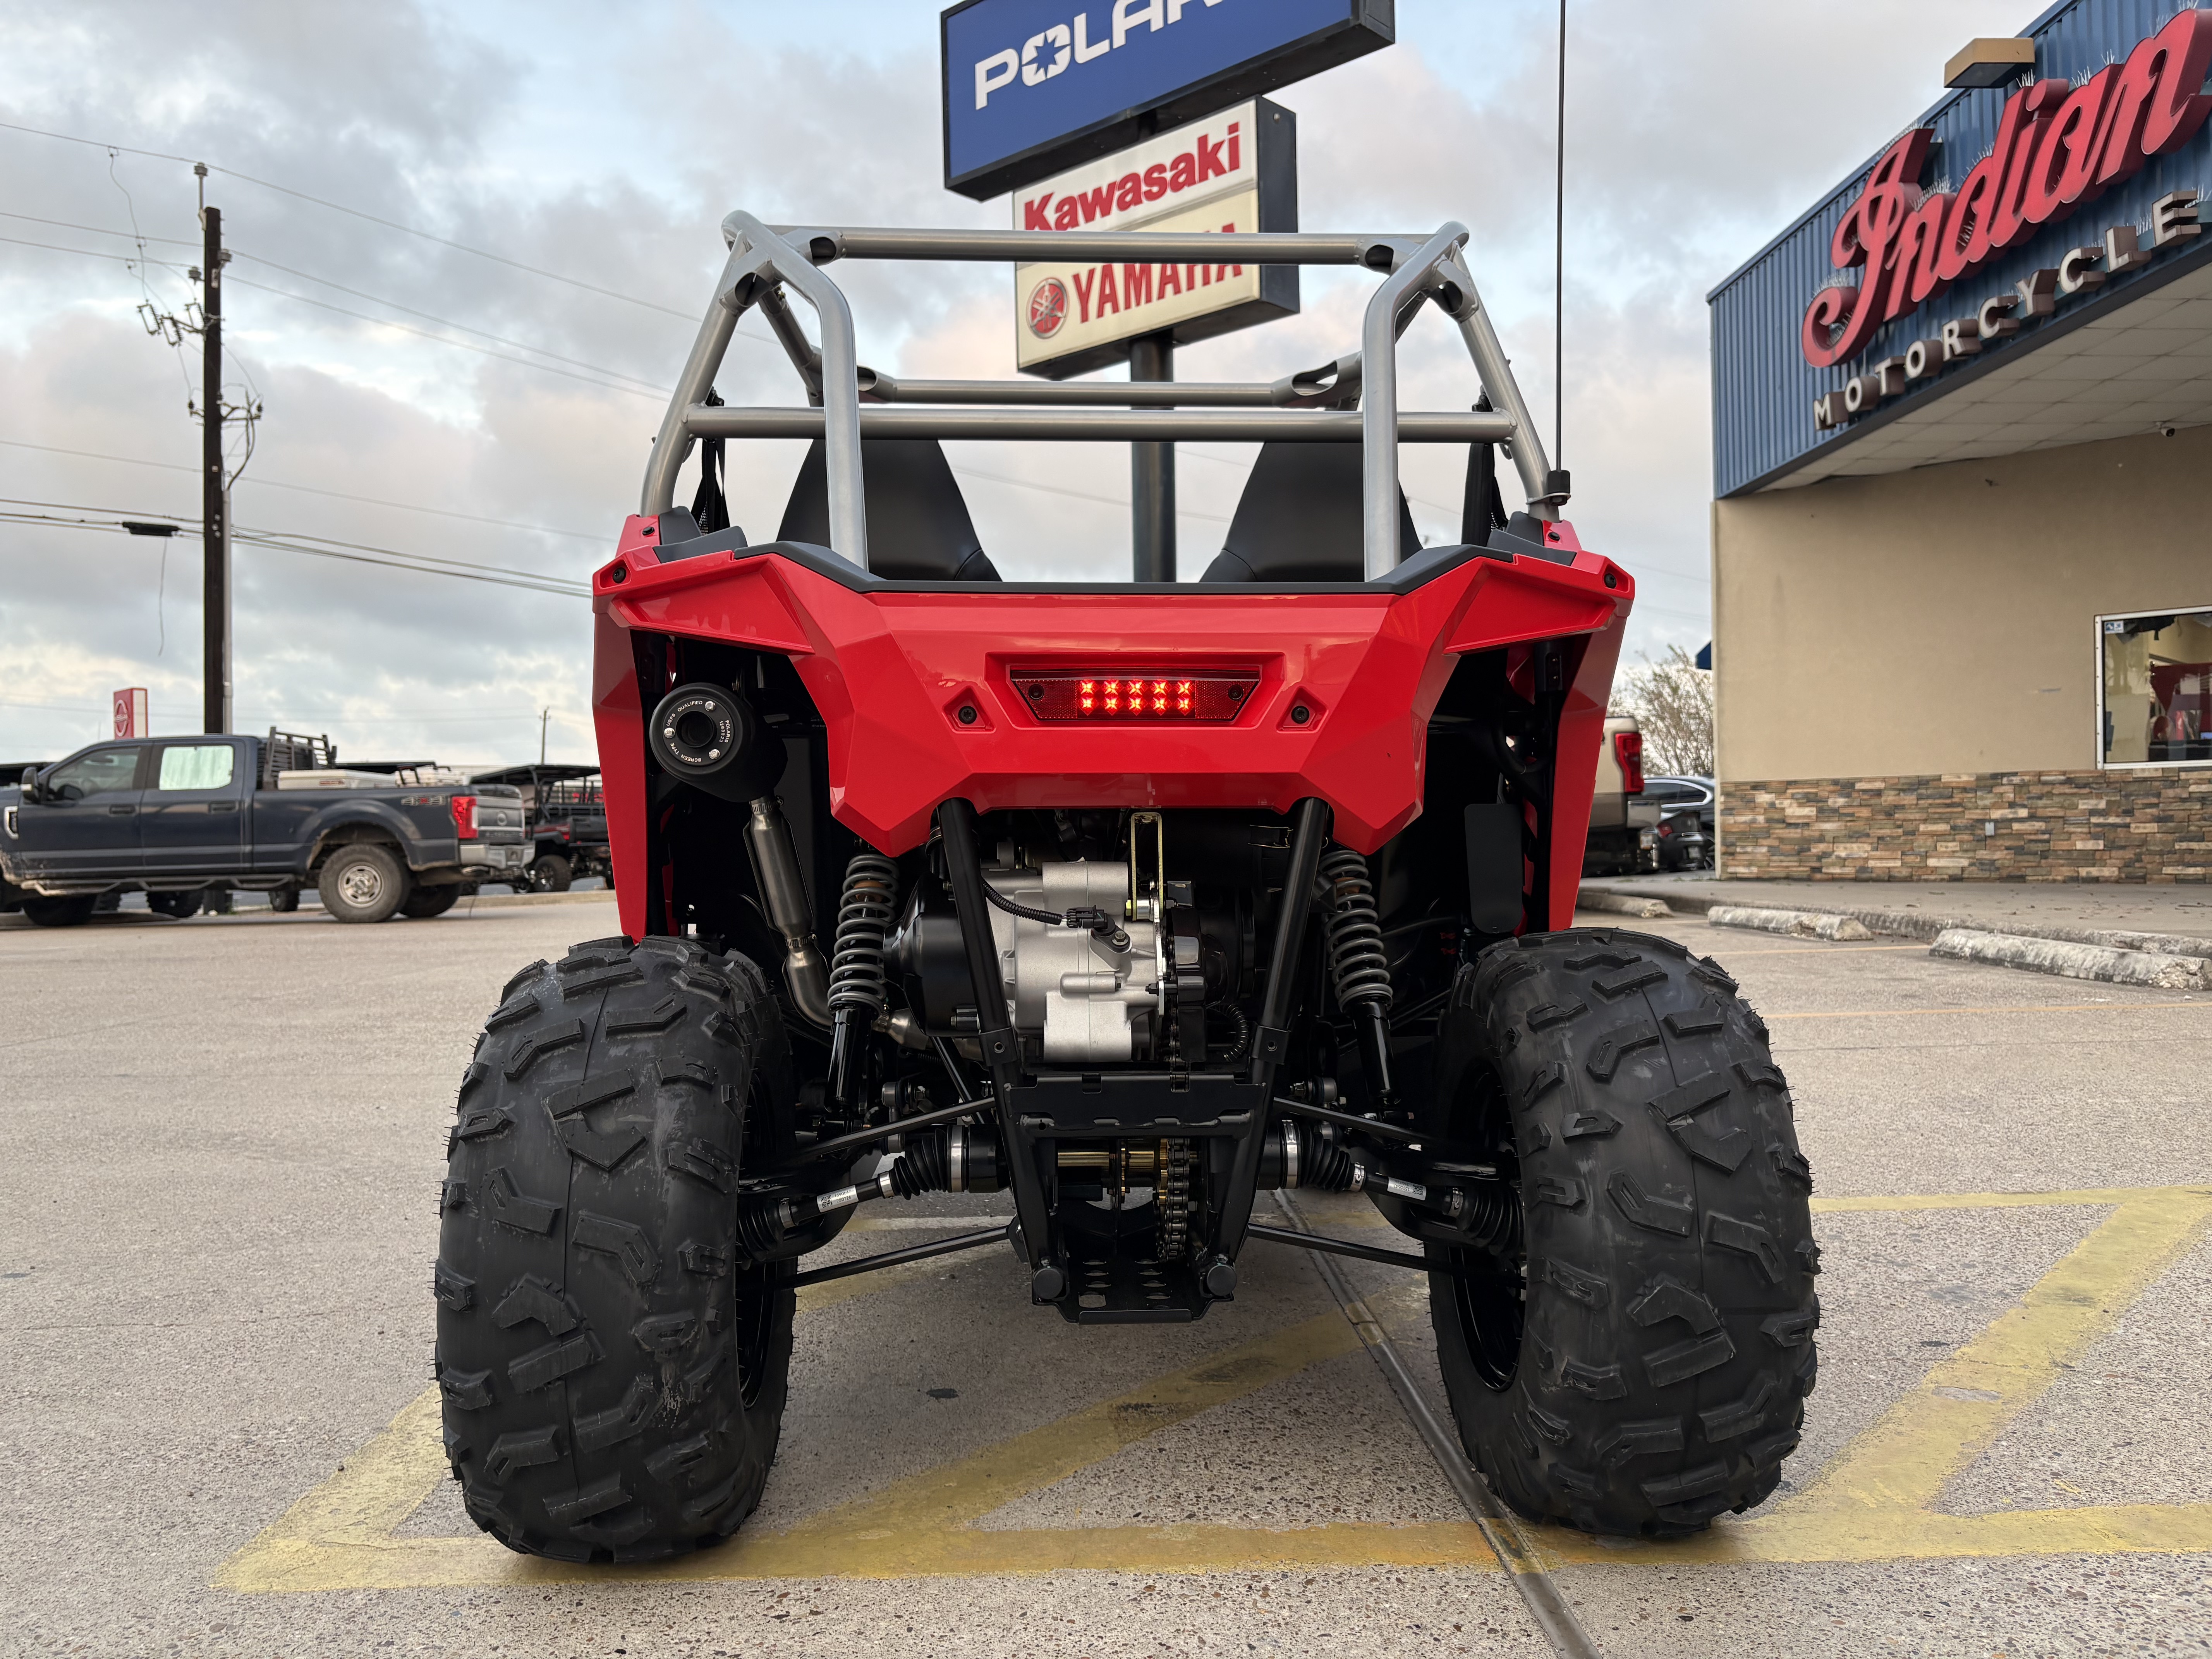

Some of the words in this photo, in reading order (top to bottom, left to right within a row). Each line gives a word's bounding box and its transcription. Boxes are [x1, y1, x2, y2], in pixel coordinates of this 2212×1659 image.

[975, 0, 1223, 110] POLA
[1024, 121, 1240, 231] Kawasaki
[1802, 8, 2212, 368] Indian
[1814, 190, 2202, 431] MOTORCYCLE
[670, 742, 679, 755] TYPE
[677, 700, 703, 712] QUALIFIED
[680, 754, 701, 763] SCREEN
